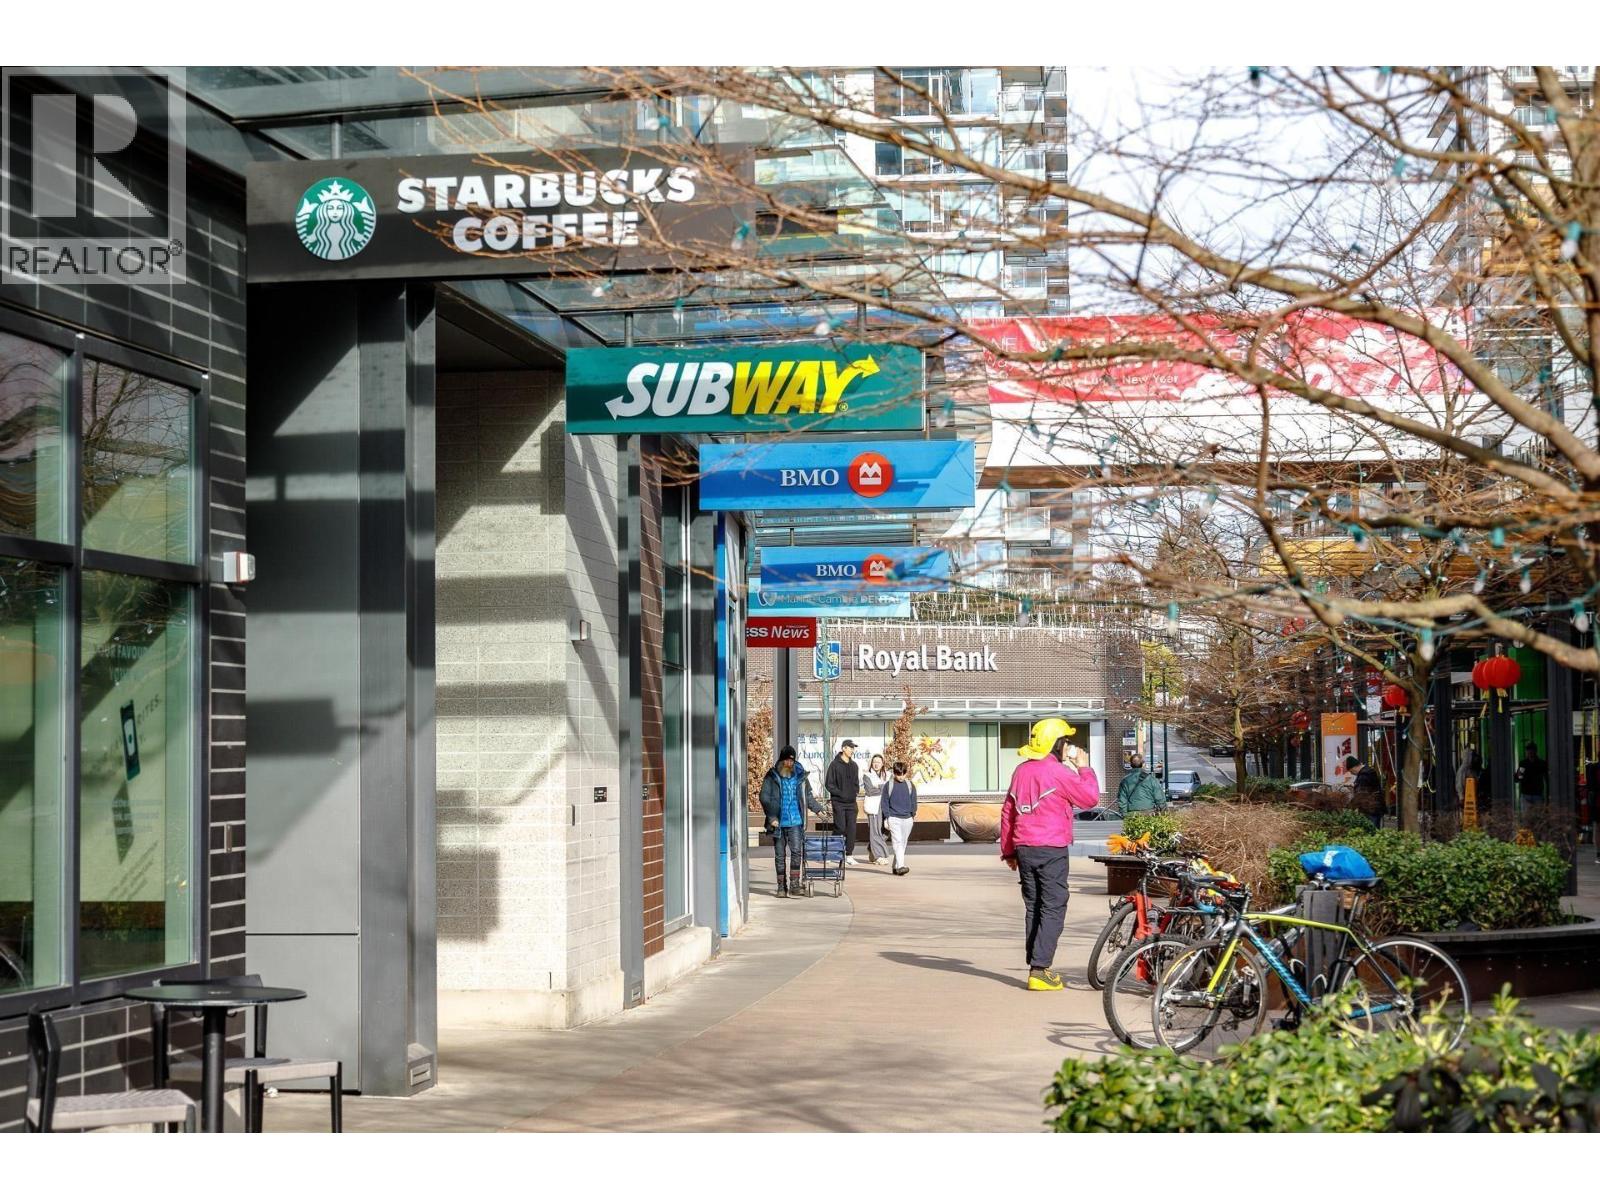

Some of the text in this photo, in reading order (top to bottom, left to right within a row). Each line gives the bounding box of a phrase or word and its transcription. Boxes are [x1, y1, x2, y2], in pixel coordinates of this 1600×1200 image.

[397, 167, 697, 213] STARBUCKS
[452, 211, 640, 252] COFFEE
[780, 468, 839, 487] BMO
[815, 564, 857, 577] BMO
[770, 625, 810, 639] News
[858, 643, 1000, 678] Royal Bank
